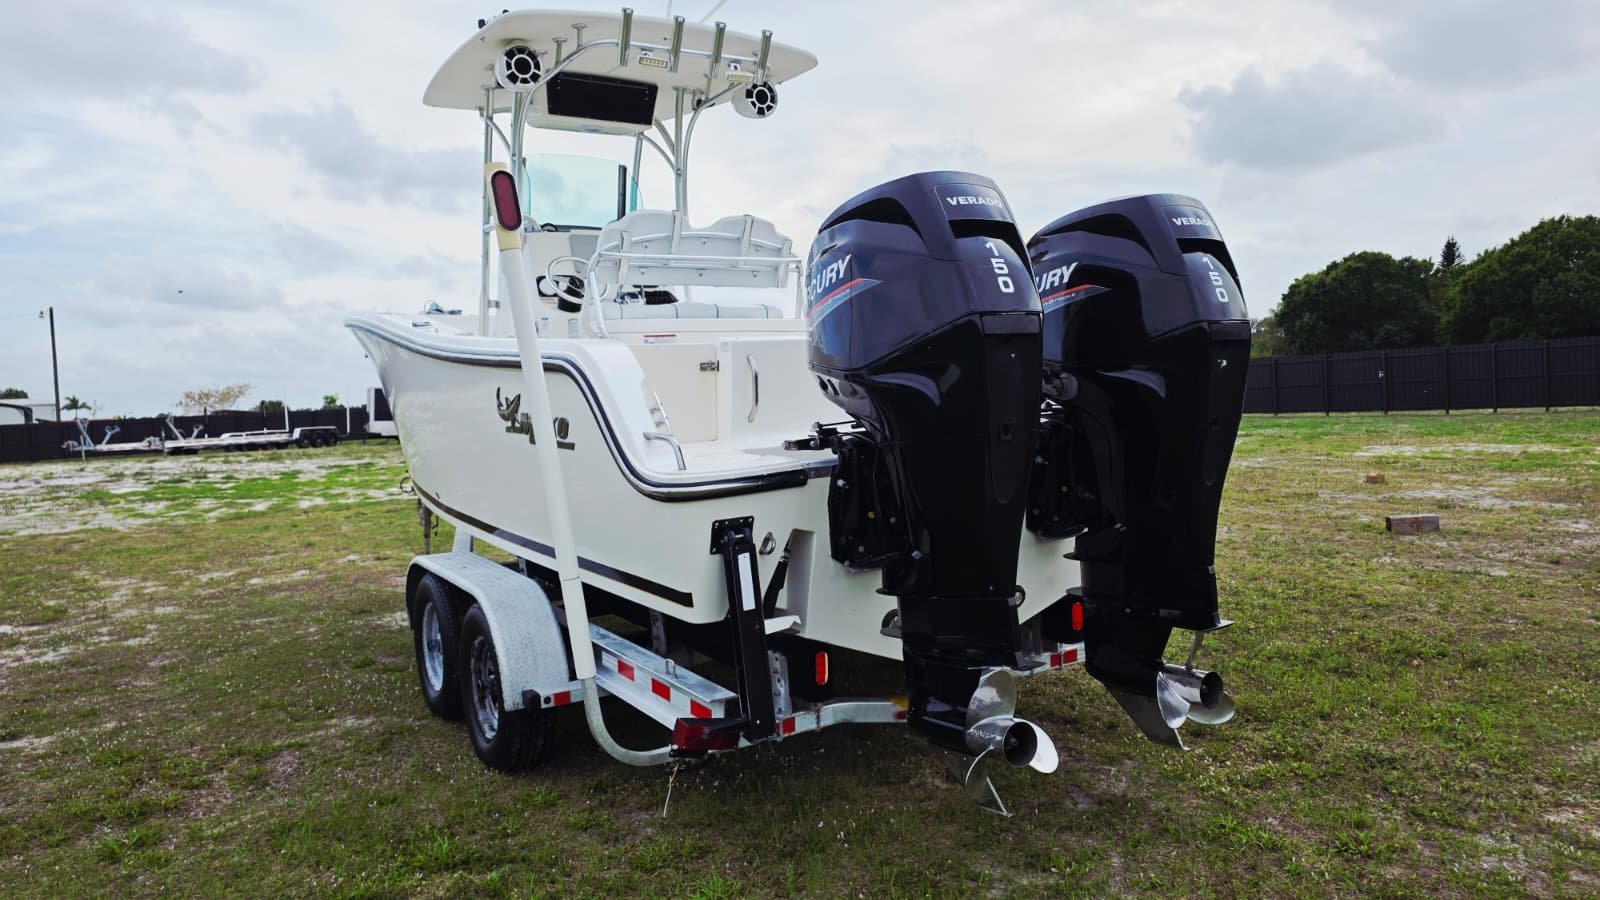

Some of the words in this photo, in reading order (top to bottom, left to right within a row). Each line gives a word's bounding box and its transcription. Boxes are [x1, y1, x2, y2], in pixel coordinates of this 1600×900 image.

[946, 196, 1003, 208] VERADO
[984, 241, 1015, 293] 150
[1202, 256, 1229, 303] 150
